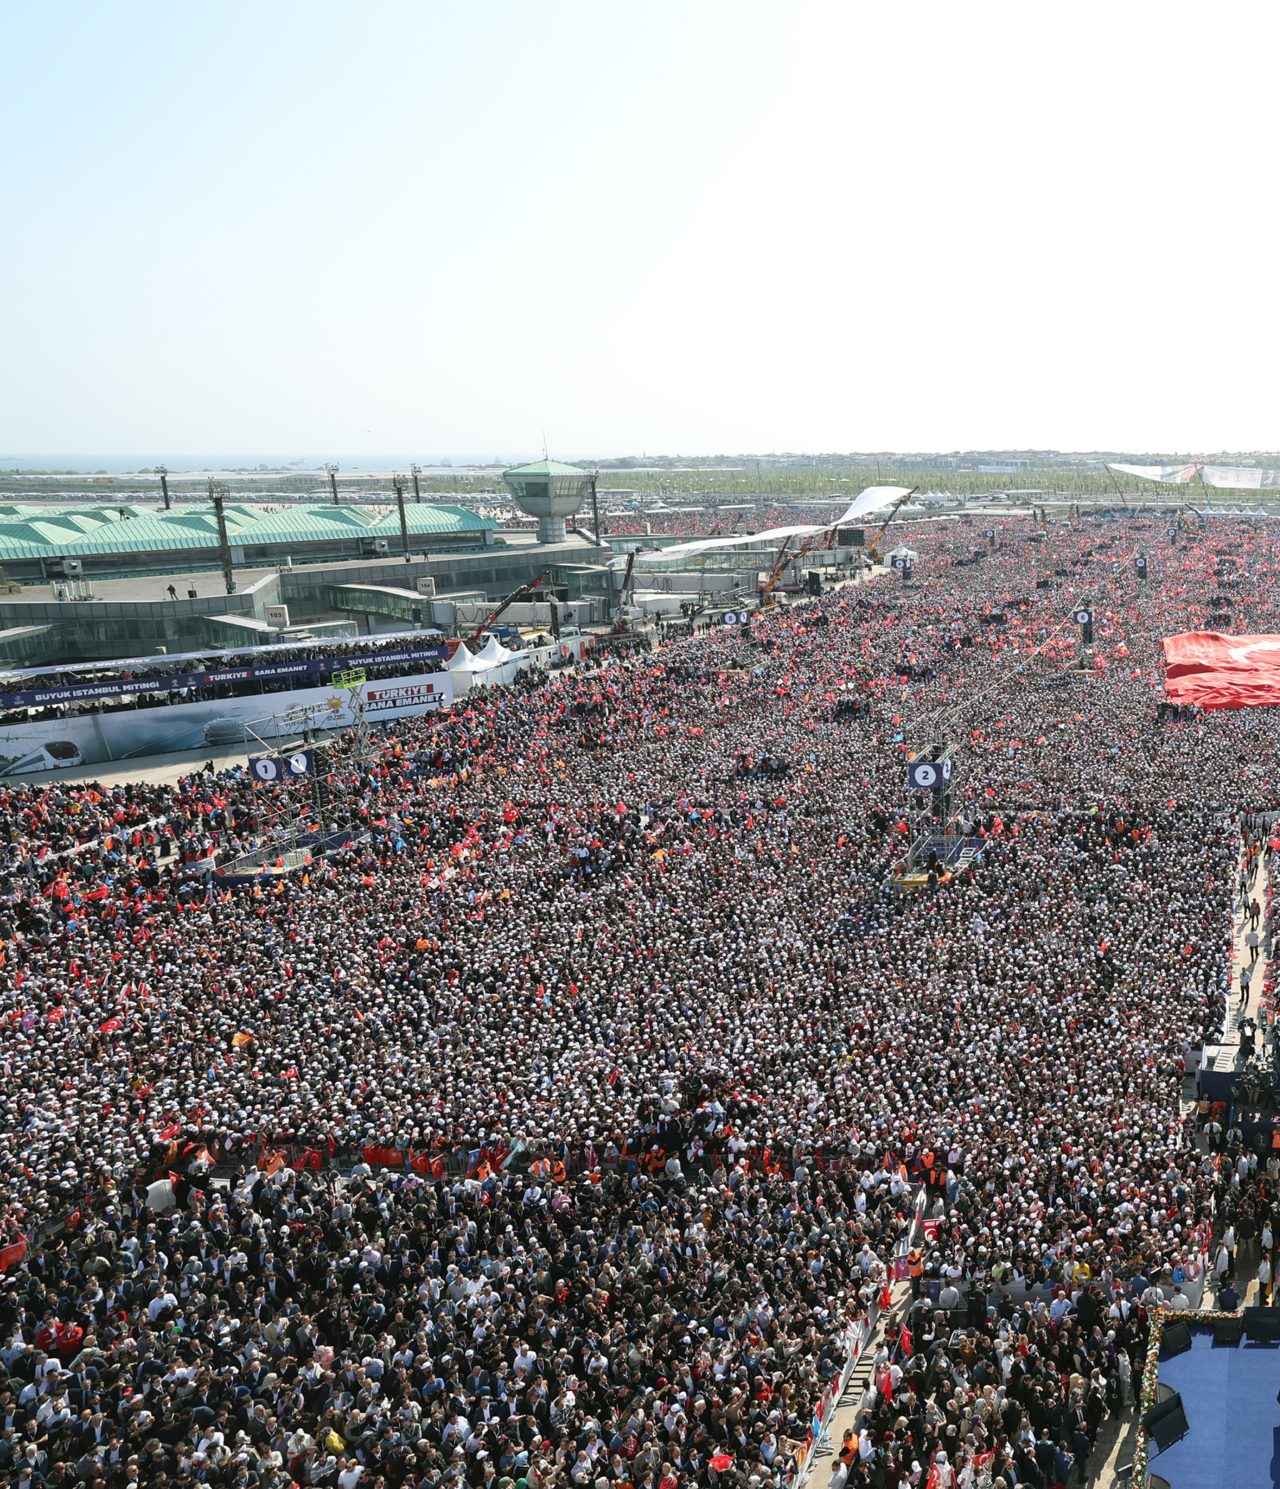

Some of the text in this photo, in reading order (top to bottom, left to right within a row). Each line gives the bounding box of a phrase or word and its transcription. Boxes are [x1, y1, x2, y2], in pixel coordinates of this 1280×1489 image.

[254, 668, 276, 676] SANA
[277, 665, 308, 673] EMANET
[395, 694, 441, 707] EMANET
[922, 770, 929, 780] 2
